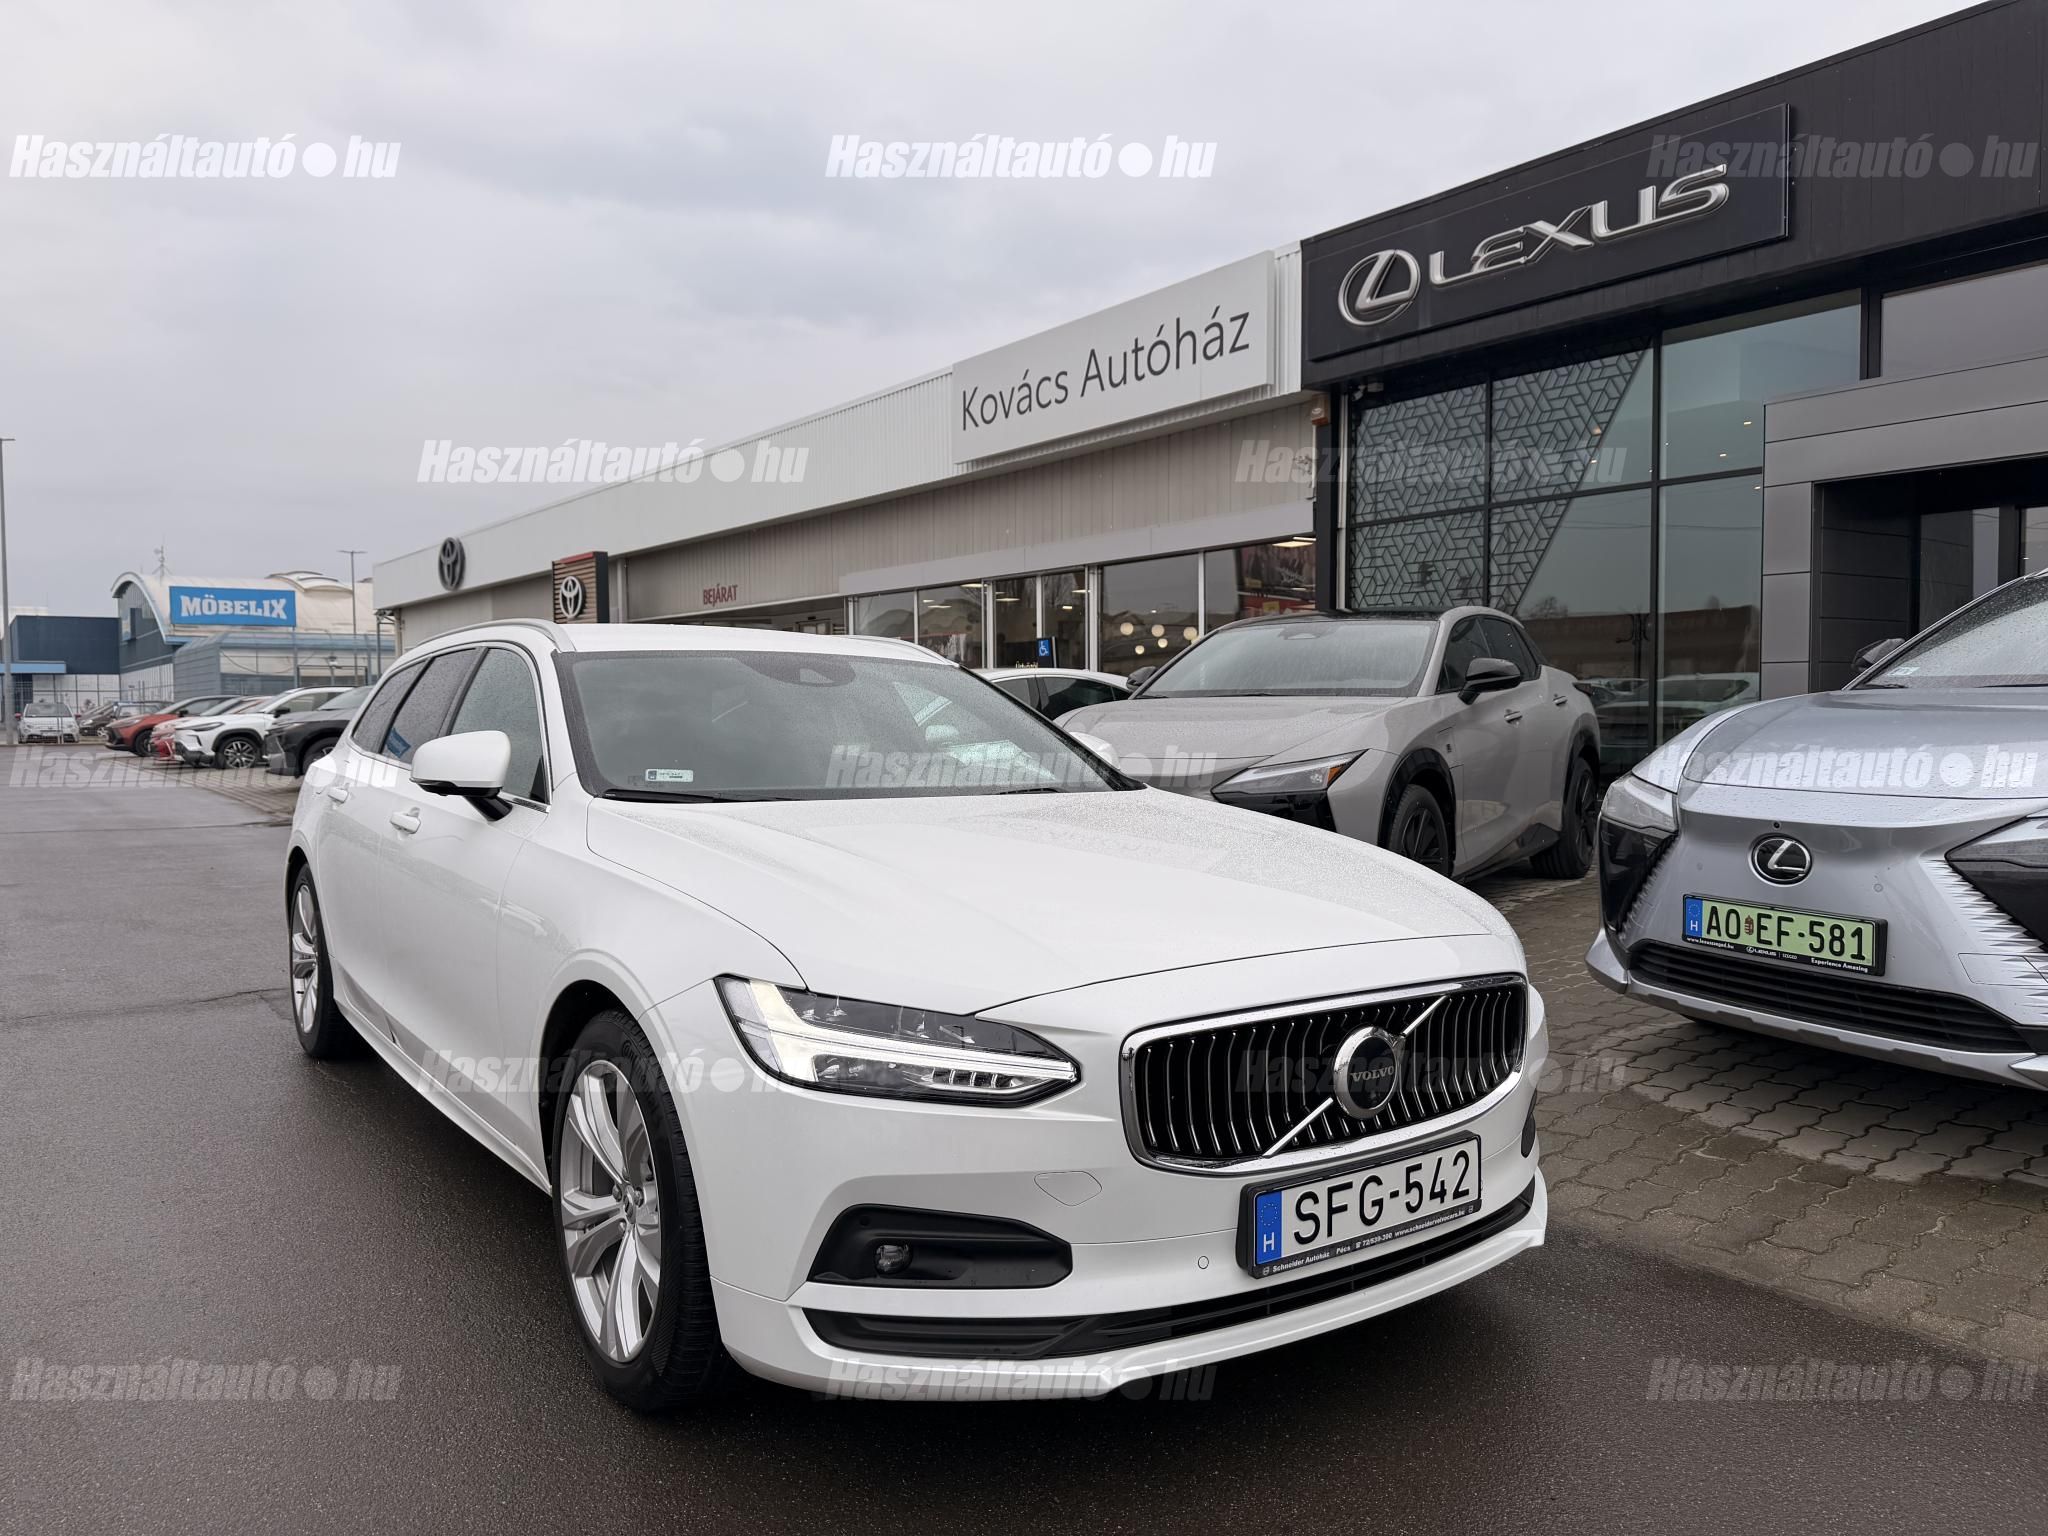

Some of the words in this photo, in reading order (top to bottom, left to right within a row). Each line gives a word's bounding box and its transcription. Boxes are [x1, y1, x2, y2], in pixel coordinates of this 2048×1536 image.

[1429, 163, 1729, 287] LEXUS
[962, 369, 1068, 431] Kovács
[1080, 305, 1250, 398] Autóház
[180, 593, 287, 620] MÖBELIX
[703, 582, 738, 608] BEJÁRAT
[1690, 919, 1699, 932] H
[1811, 957, 1842, 970] Experience
[1842, 962, 1869, 974] Amazing
[1350, 1065, 1395, 1083] VOLVO
[1293, 1149, 1470, 1245] SFG-542
[1263, 1231, 1275, 1253] H
[1272, 1258, 1305, 1273] Schneider
[1305, 1251, 1331, 1265] Autóház
[1336, 1245, 1351, 1255] Pécs
